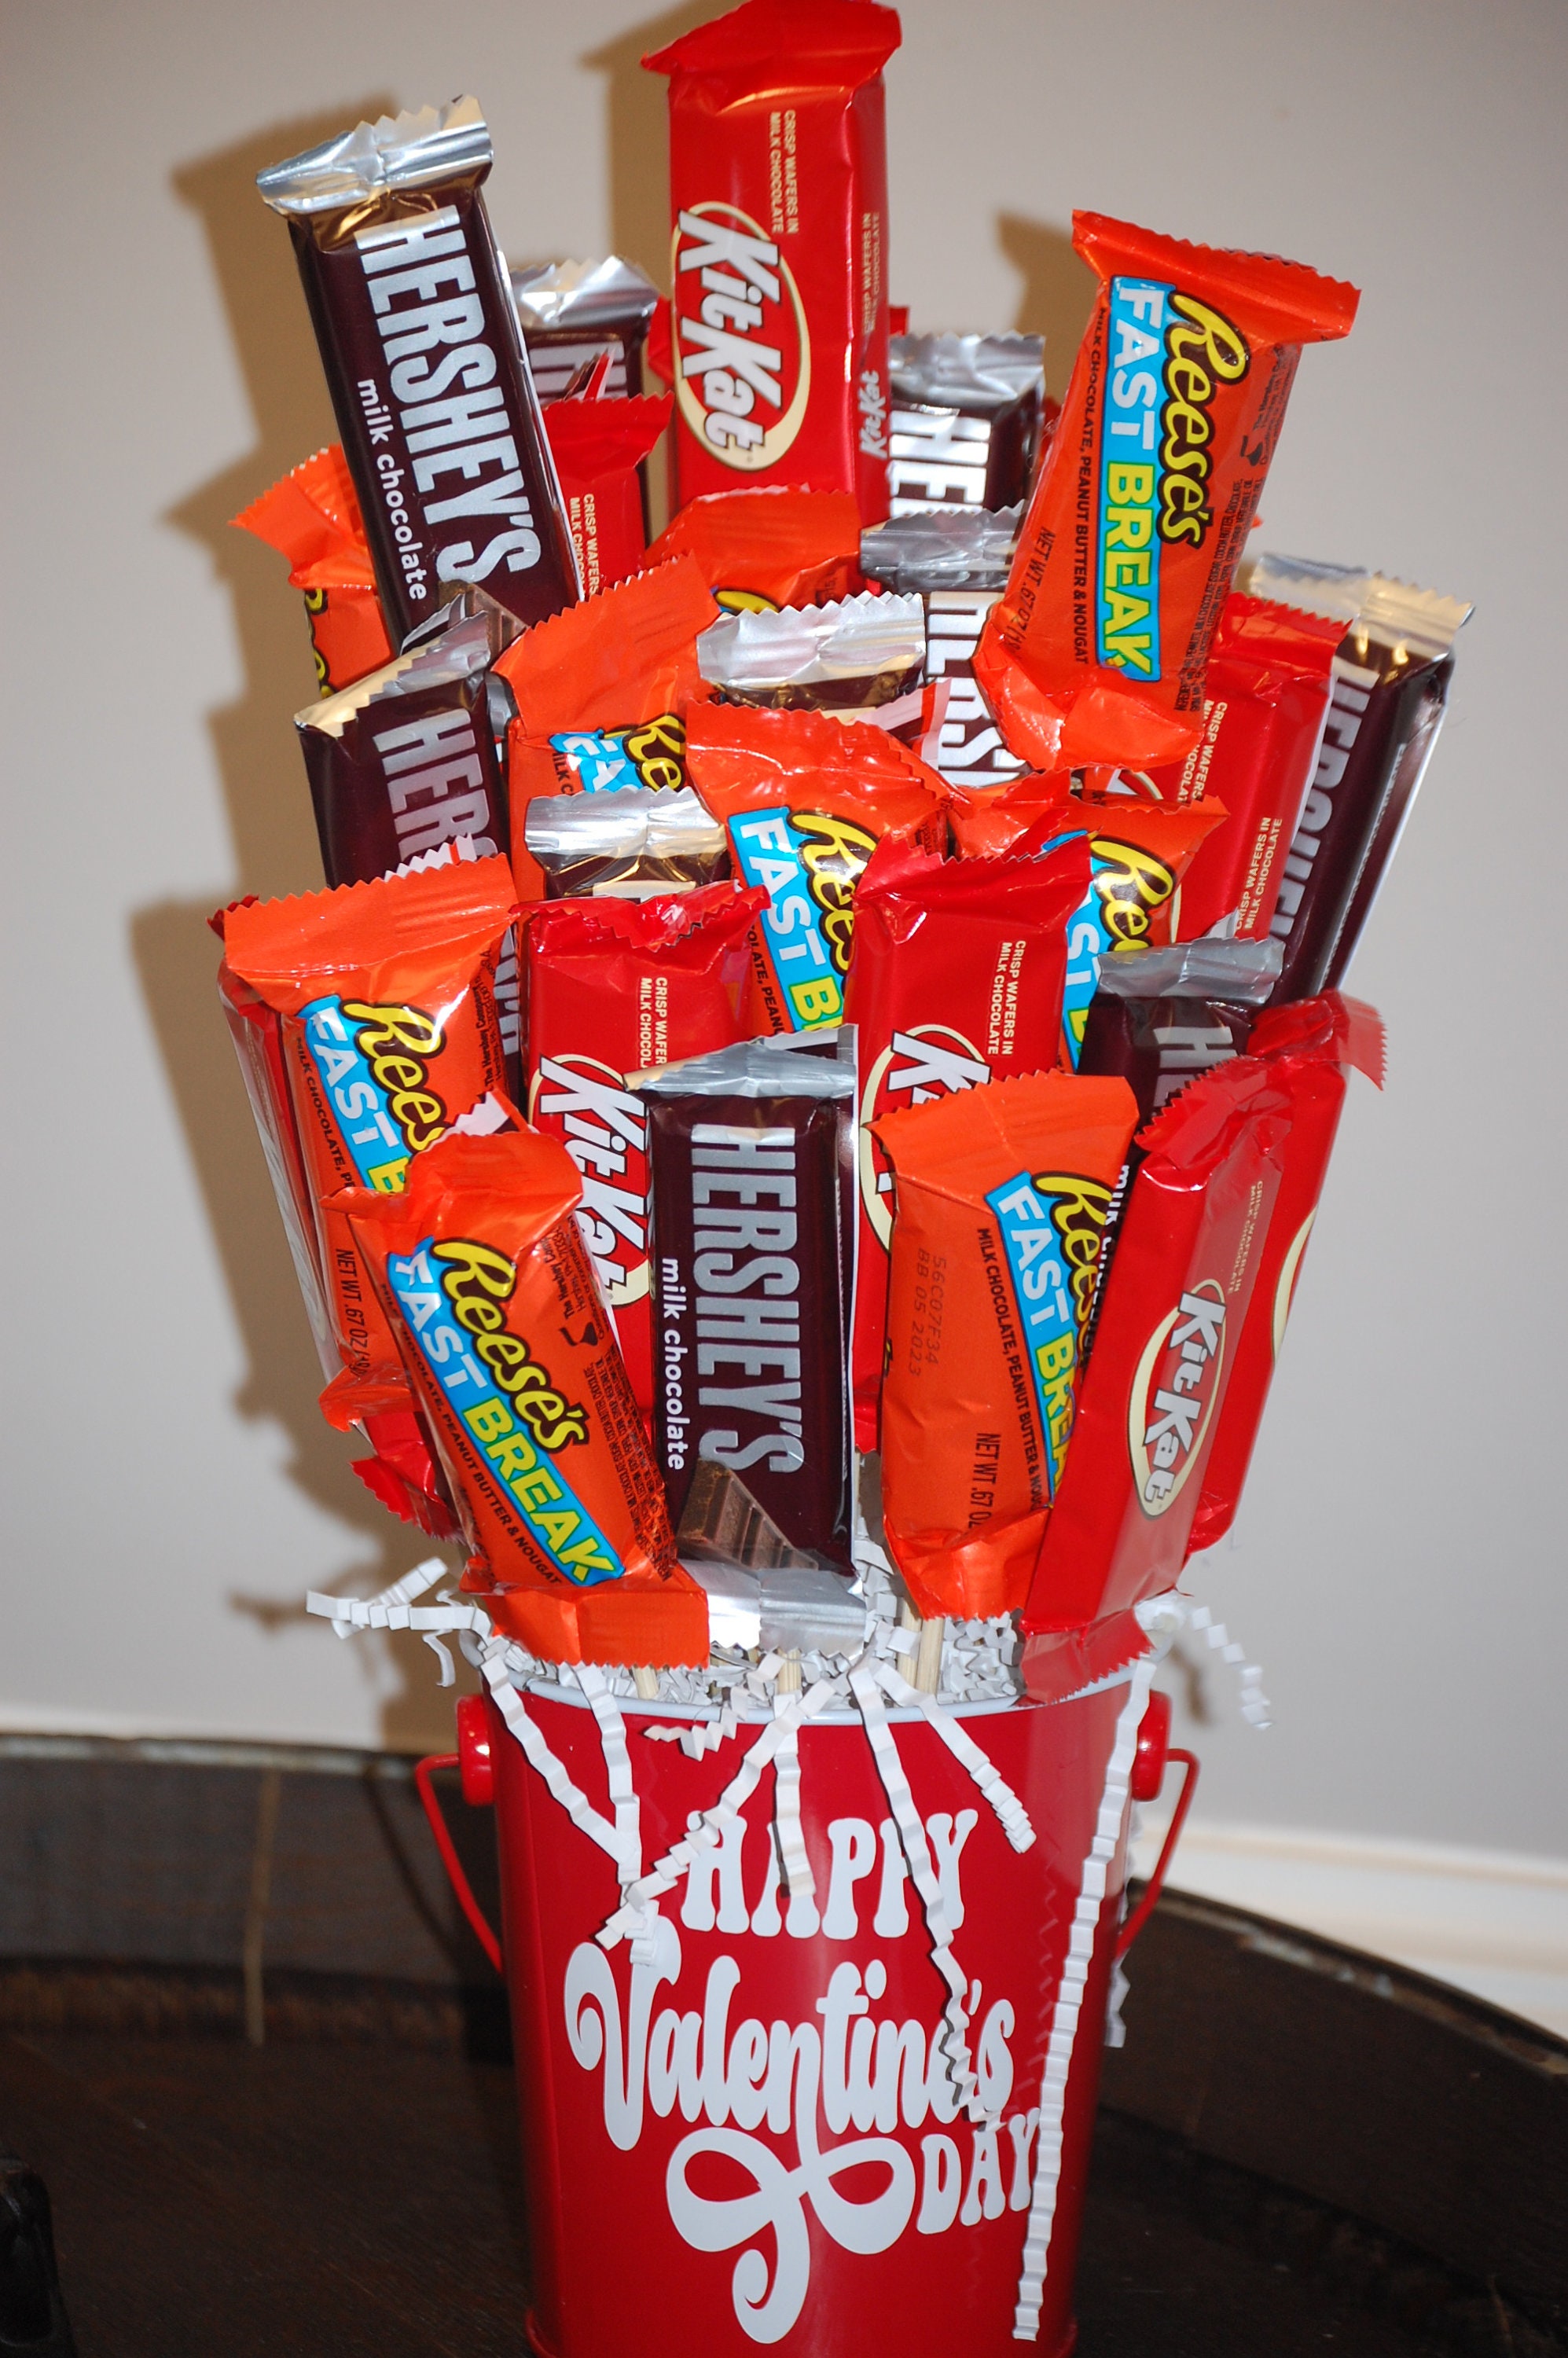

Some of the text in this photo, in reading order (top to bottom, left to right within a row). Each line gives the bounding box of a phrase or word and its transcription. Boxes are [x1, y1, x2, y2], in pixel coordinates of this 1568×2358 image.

[769, 112, 784, 234] MILK CHOCOLATE
[783, 109, 799, 234] CRISP WAFERS IN
[353, 204, 542, 584] HERSHEY'S
[1079, 350, 1101, 452] CHOCOLATE,
[1161, 293, 1247, 544] Reese's
[357, 378, 427, 601] milk chocolate
[570, 497, 581, 531] MILK
[1075, 456, 1092, 521] PEANUT
[1103, 286, 1166, 674] FAST BREAK
[583, 494, 600, 595] CRISP WAFERS
[1025, 558, 1046, 586] WT
[1034, 527, 1056, 560] NET
[1073, 524, 1089, 587] BUTTER
[1073, 590, 1087, 601] &
[1073, 603, 1089, 664] NOUGAT
[1192, 702, 1228, 799] CRISP WAFERS
[740, 817, 826, 967] FAST
[1236, 817, 1272, 931] CRISP WAFERS IN
[1244, 818, 1283, 930] MILK CHOCOLATE
[640, 977, 653, 1069] MILK CHOCOL
[655, 977, 668, 1065] CRISP WAFER
[987, 942, 1013, 1056] MILK CHOCOLATE
[1001, 940, 1026, 1056] CRISP WAFERS IN
[296, 1036, 346, 1171] MILK CHOCOLATE,
[309, 1006, 400, 1148] FAST
[335, 1247, 358, 1277] NET
[340, 1280, 362, 1302] WT
[546, 1263, 571, 1301] Hershey
[977, 1228, 997, 1264] MILK
[997, 1185, 1070, 1327] FAST
[344, 1304, 365, 1327] .67
[348, 1328, 369, 1350] OZ
[560, 1300, 575, 1318] The
[689, 1123, 805, 1473] HERSHEY'S
[913, 1285, 927, 1313] 05
[986, 1265, 1017, 1356] CHOCOLATE,
[431, 1240, 586, 1450] Reese's
[661, 1258, 691, 1471] milk chocolate
[908, 1320, 925, 1376] 2023
[1007, 1355, 1030, 1410] PEANUT
[395, 1250, 489, 1389] FAST
[462, 1396, 616, 1583] BREAK
[975, 1432, 1002, 1460] NET
[1019, 1413, 1039, 1465] BUTTER
[442, 1412, 478, 1471] PEANUT
[474, 1472, 512, 1526] BUTTER
[507, 1526, 520, 1537] &
[515, 1537, 564, 1585] NOUGAT
[970, 1487, 995, 1508] .67
[972, 1462, 998, 1485] WT
[1028, 1465, 1040, 1475] &
[564, 1915, 1015, 2344] Valentine's
[916, 2107, 1041, 2235] DAY
